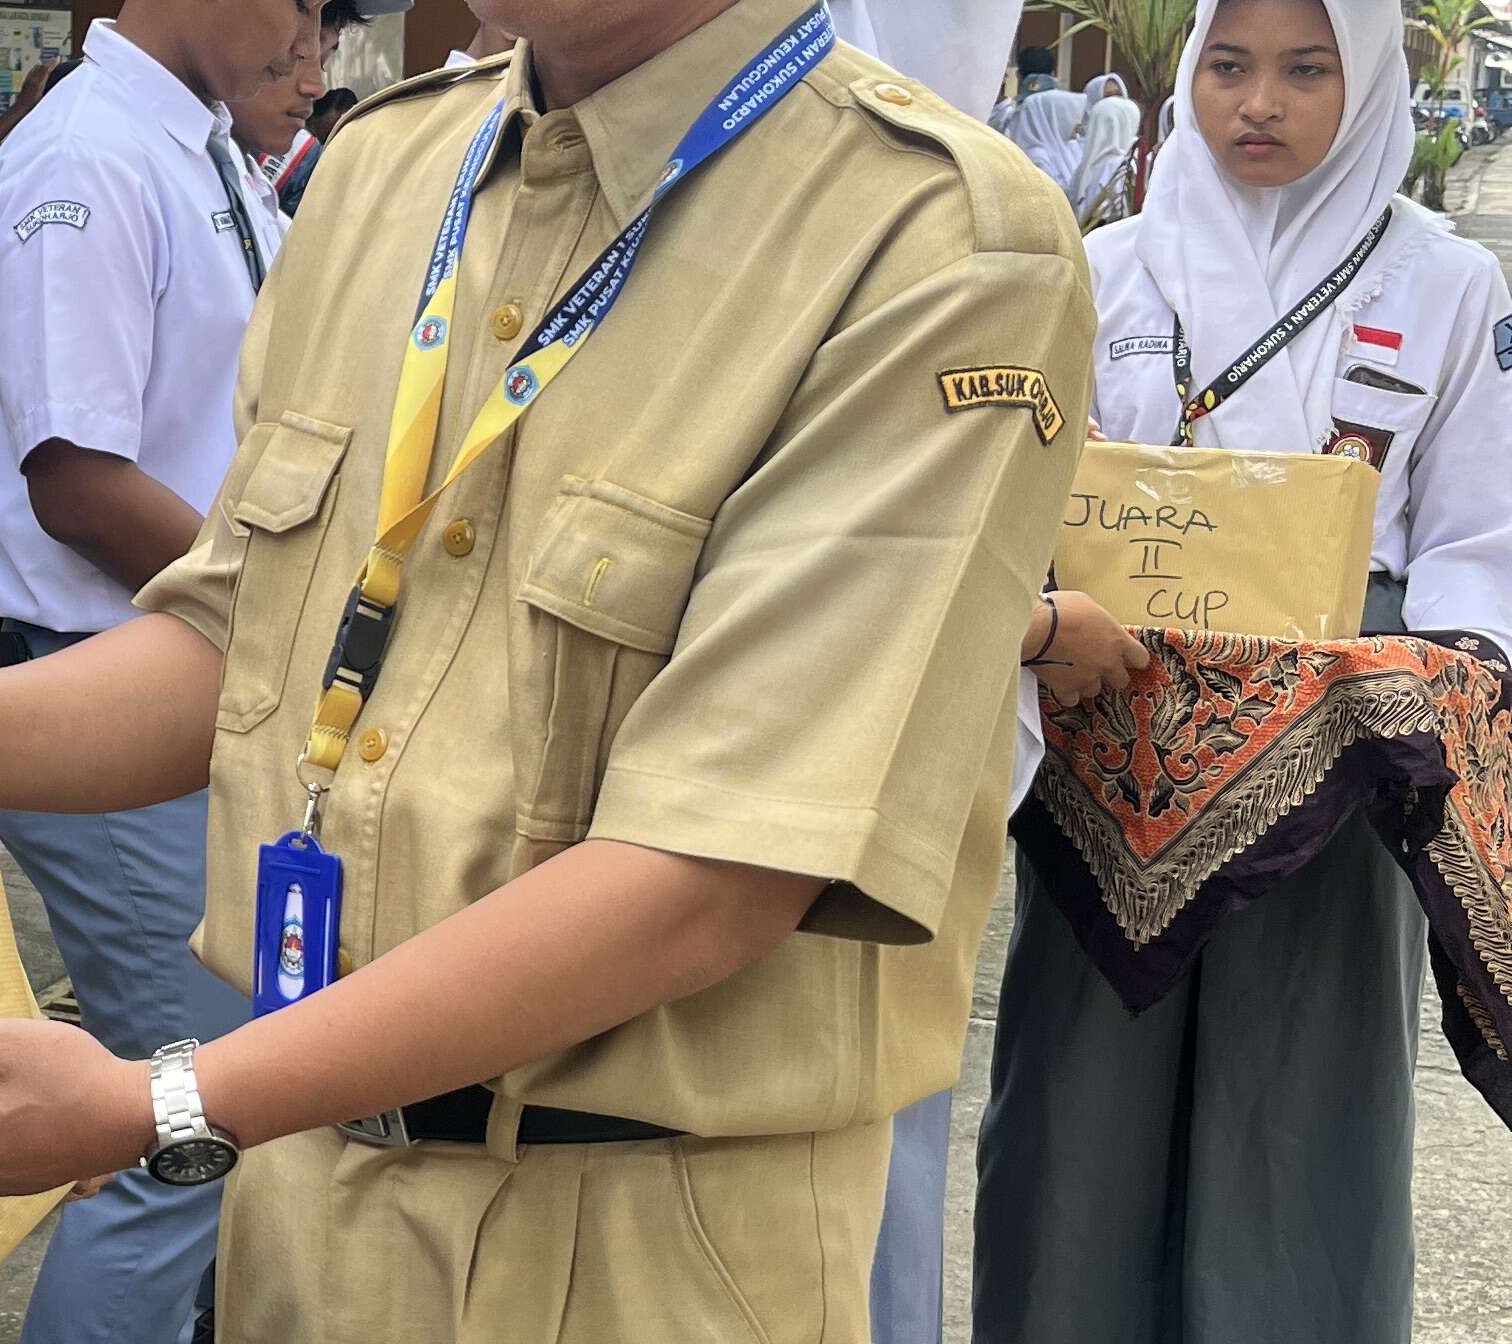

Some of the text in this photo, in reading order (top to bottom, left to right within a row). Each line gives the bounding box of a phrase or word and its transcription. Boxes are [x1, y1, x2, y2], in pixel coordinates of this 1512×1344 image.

[718, 34, 800, 112] KEUNGGULAN
[794, 55, 805, 66] 1
[722, 61, 798, 130] SUKOHARJO
[538, 312, 568, 347] SMK
[563, 249, 620, 314] VETERAN
[1331, 262, 1354, 285] SMK
[563, 313, 592, 348] SMK
[588, 268, 624, 317] PUSAT
[1290, 282, 1337, 325] VETERAN
[1227, 327, 1287, 383] SUKOHARJO
[1063, 492, 1218, 534] JUARA
[1146, 588, 1229, 630] CUP
